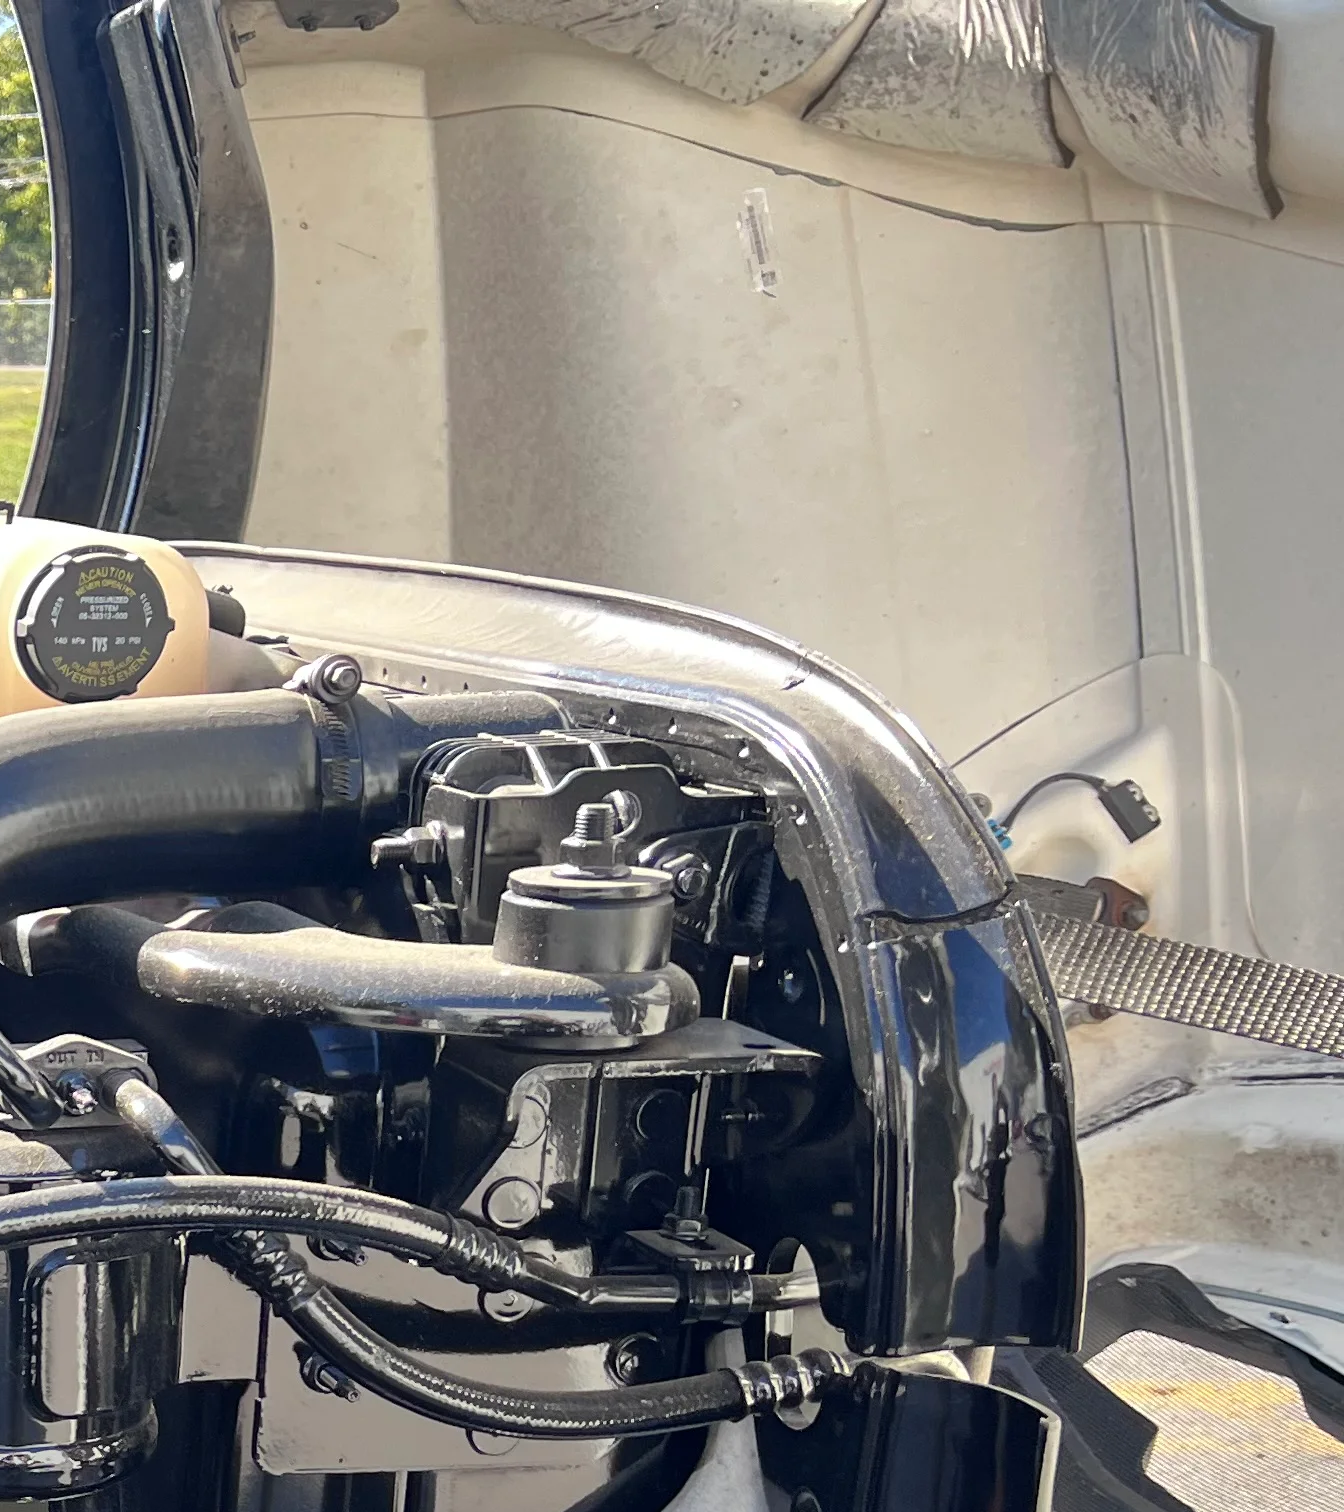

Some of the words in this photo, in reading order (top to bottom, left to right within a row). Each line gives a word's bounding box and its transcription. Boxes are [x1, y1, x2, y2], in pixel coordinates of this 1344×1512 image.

[88, 566, 135, 583] CAUTION
[92, 636, 109, 653] TVS
[114, 636, 126, 645] 20
[59, 647, 151, 688] AVERTISSEMENT
[47, 1050, 77, 1063] OUT
[86, 1049, 105, 1063] IN
